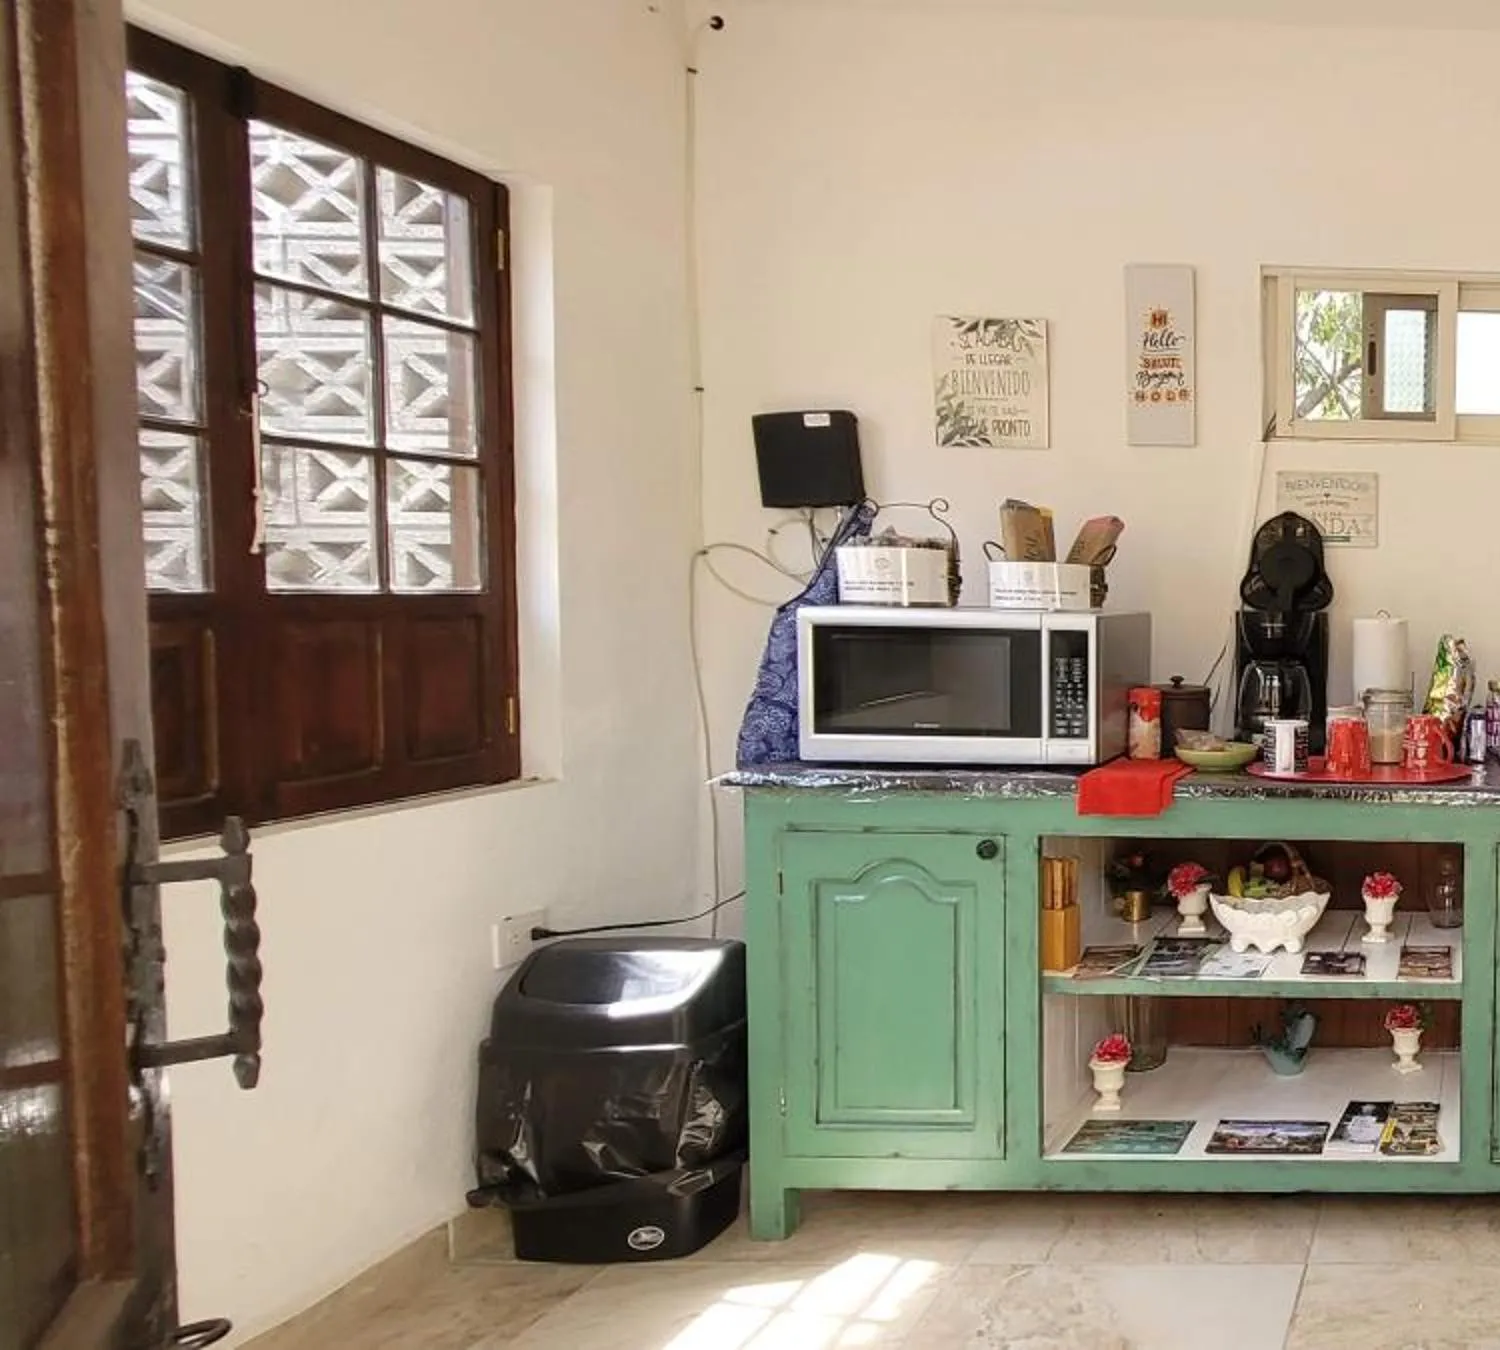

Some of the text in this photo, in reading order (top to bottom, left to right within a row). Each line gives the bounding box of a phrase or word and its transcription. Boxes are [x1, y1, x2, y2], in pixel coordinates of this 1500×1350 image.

[1142, 328, 1187, 348] Hello
[951, 369, 1031, 397] BIENVENIDO
[991, 418, 1031, 437] PRONTO
